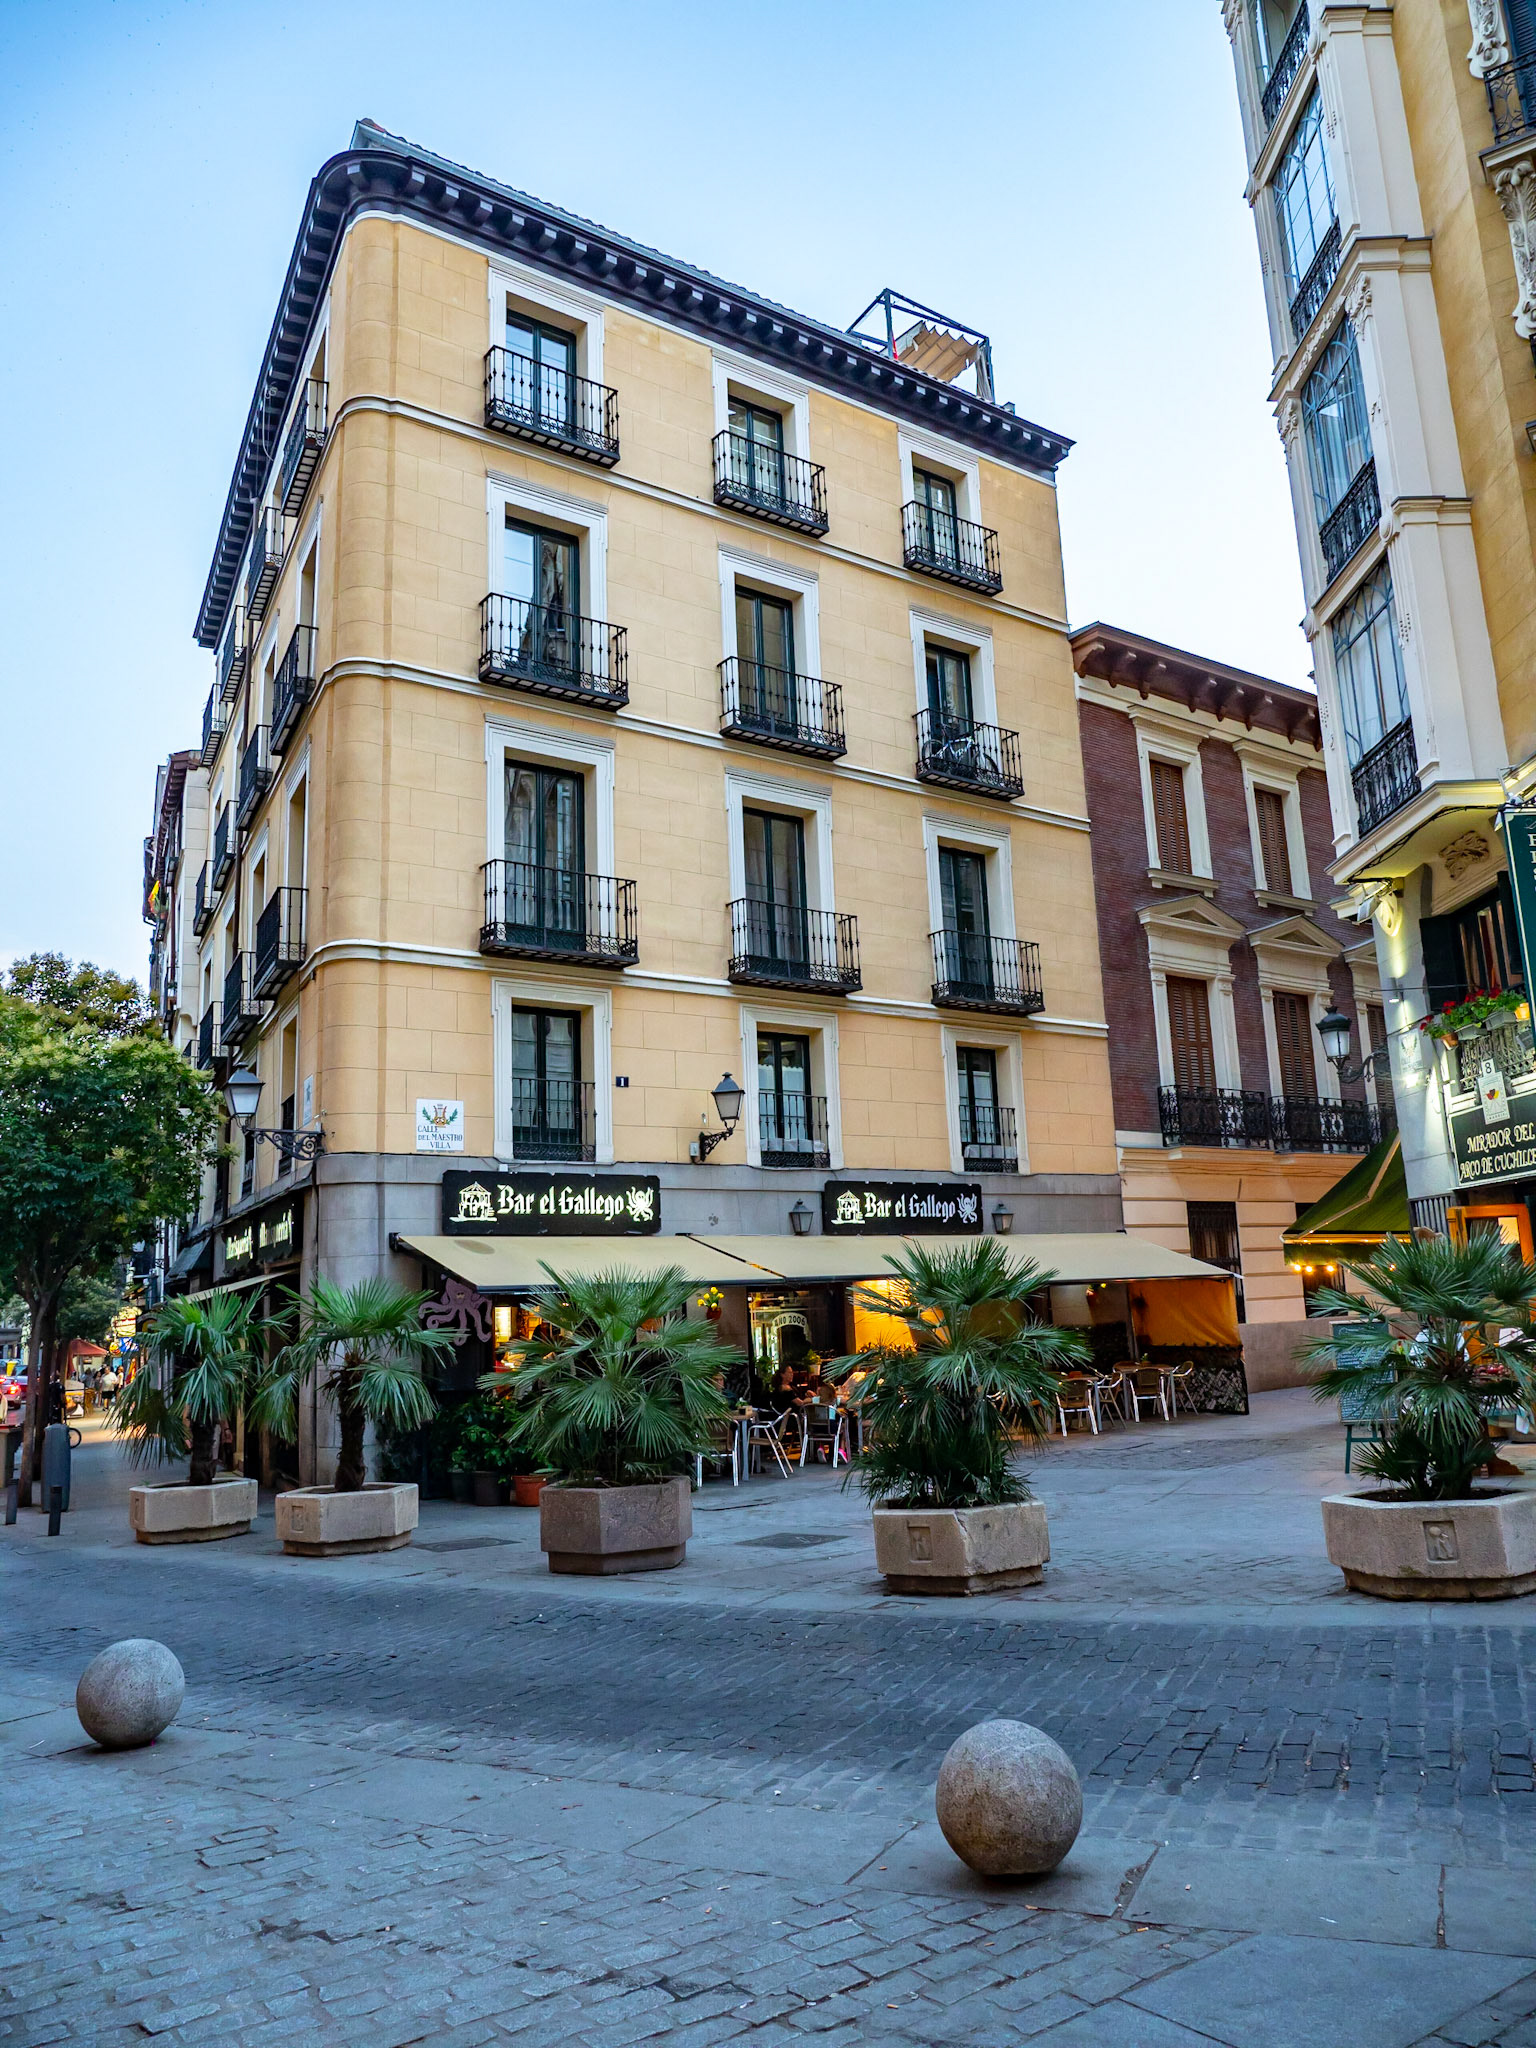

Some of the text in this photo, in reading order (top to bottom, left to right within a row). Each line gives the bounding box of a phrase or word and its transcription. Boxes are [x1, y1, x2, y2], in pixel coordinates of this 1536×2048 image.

[1484, 1062, 1493, 1074] 8
[620, 1077, 625, 1087] 1
[417, 1125, 439, 1133] CALLE
[431, 1133, 463, 1141] MAESTRO
[1467, 1122, 1536, 1153] MIRADOR DEL
[429, 1141, 451, 1149] VILLA
[1459, 1159, 1481, 1181] ARCO
[1481, 1156, 1494, 1174] DE
[497, 1184, 626, 1221] Bar el Gallego
[864, 1192, 956, 1223] Bar el Gallego
